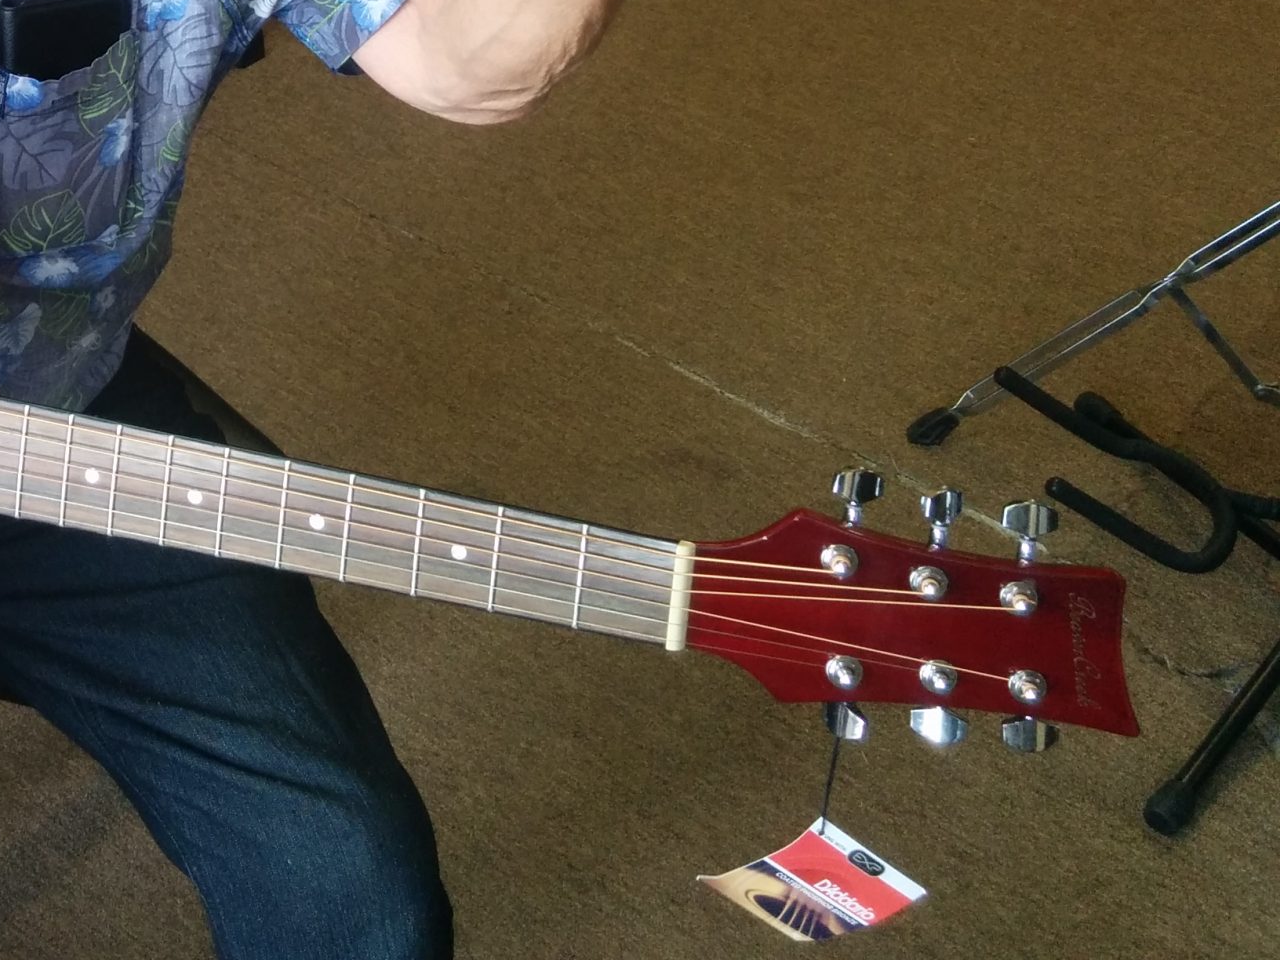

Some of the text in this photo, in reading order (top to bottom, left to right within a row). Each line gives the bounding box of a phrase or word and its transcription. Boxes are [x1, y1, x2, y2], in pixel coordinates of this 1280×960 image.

[775, 872, 800, 888] COATED
[832, 904, 860, 926] BRONZE
[813, 878, 876, 920] D'Addario
